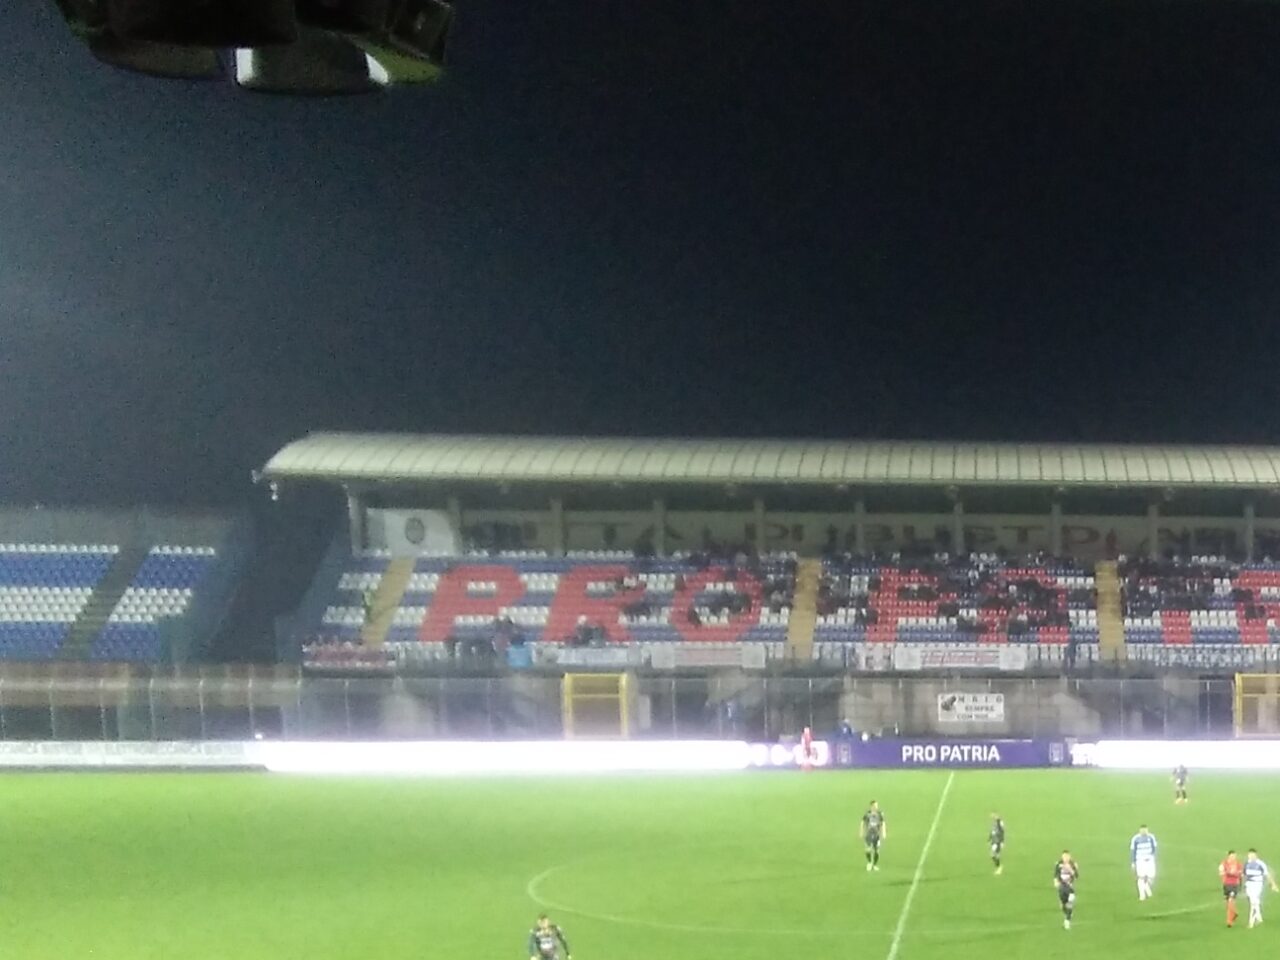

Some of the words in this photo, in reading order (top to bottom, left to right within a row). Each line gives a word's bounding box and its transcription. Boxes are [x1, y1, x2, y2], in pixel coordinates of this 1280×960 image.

[417, 564, 764, 643] PRO
[902, 745, 935, 762] PRO
[940, 745, 1000, 762] PATRIA
